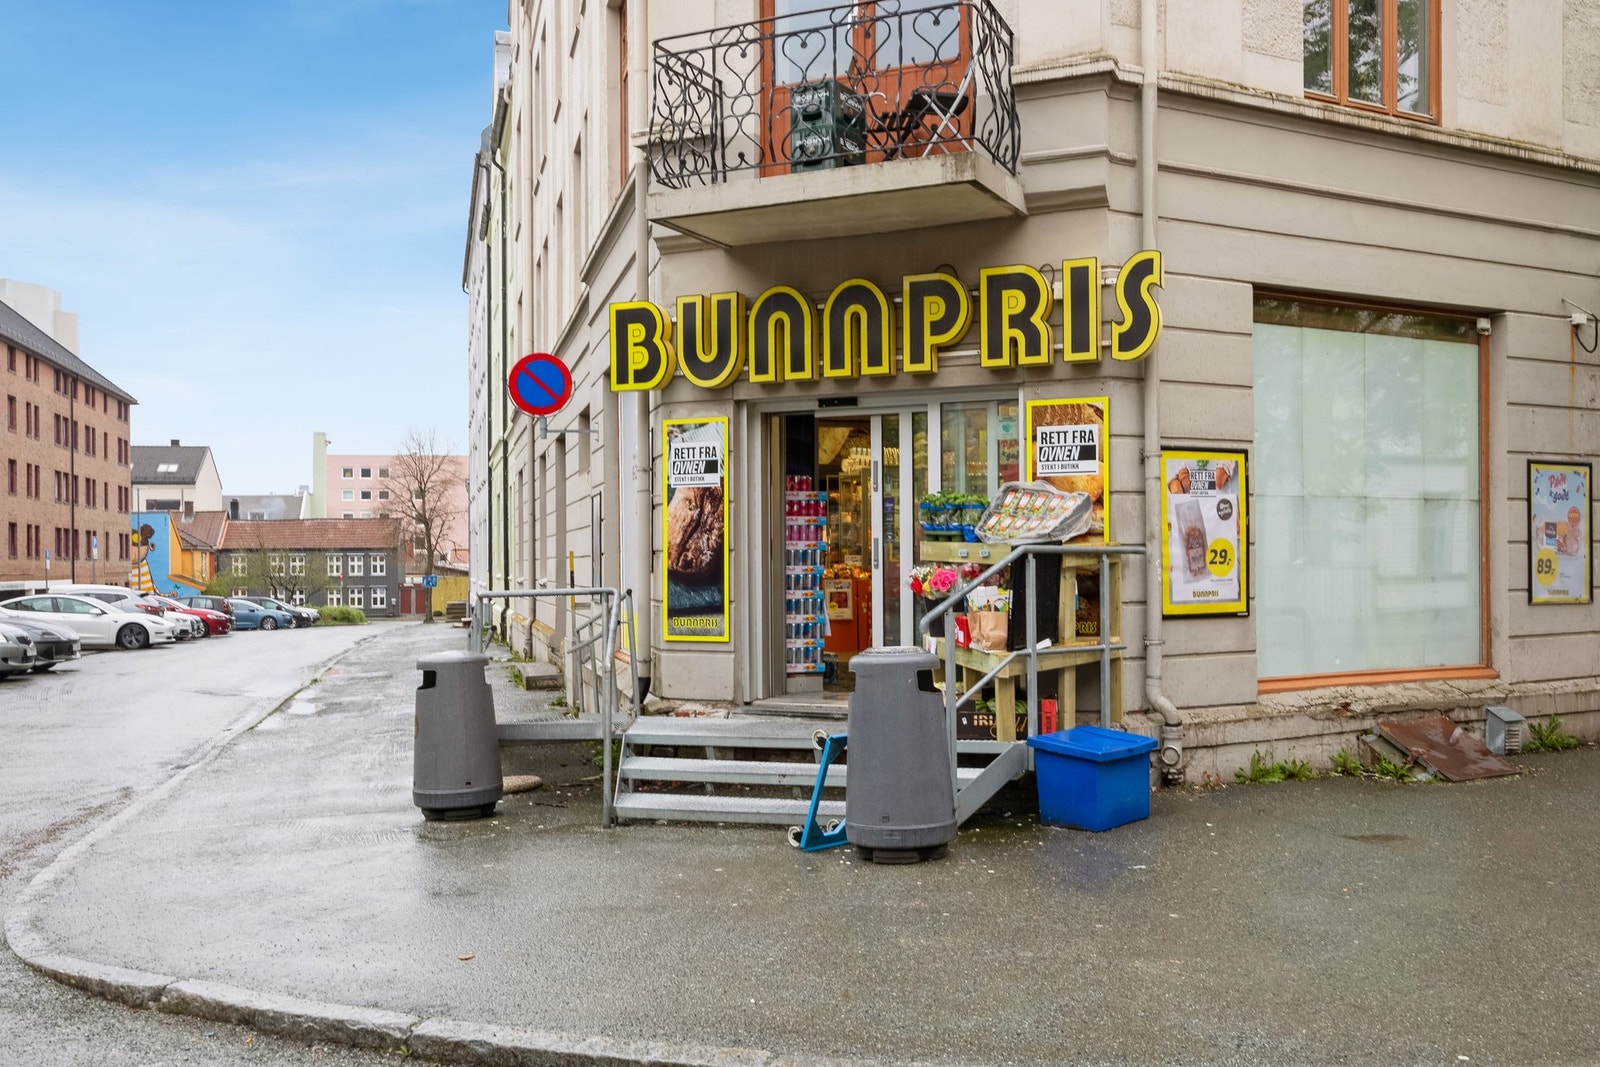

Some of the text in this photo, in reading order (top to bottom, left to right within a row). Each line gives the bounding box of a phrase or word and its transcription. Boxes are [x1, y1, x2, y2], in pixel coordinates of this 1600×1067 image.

[609, 250, 1164, 392] BUNNPRIS
[1041, 430, 1094, 444] RETT FRA
[674, 446, 717, 459] RETT FRA
[1040, 446, 1080, 461] OVNEN
[673, 460, 705, 474] OVNEN
[1191, 471, 1215, 480] RETT FRA
[673, 617, 718, 628] BUNNPRIS
